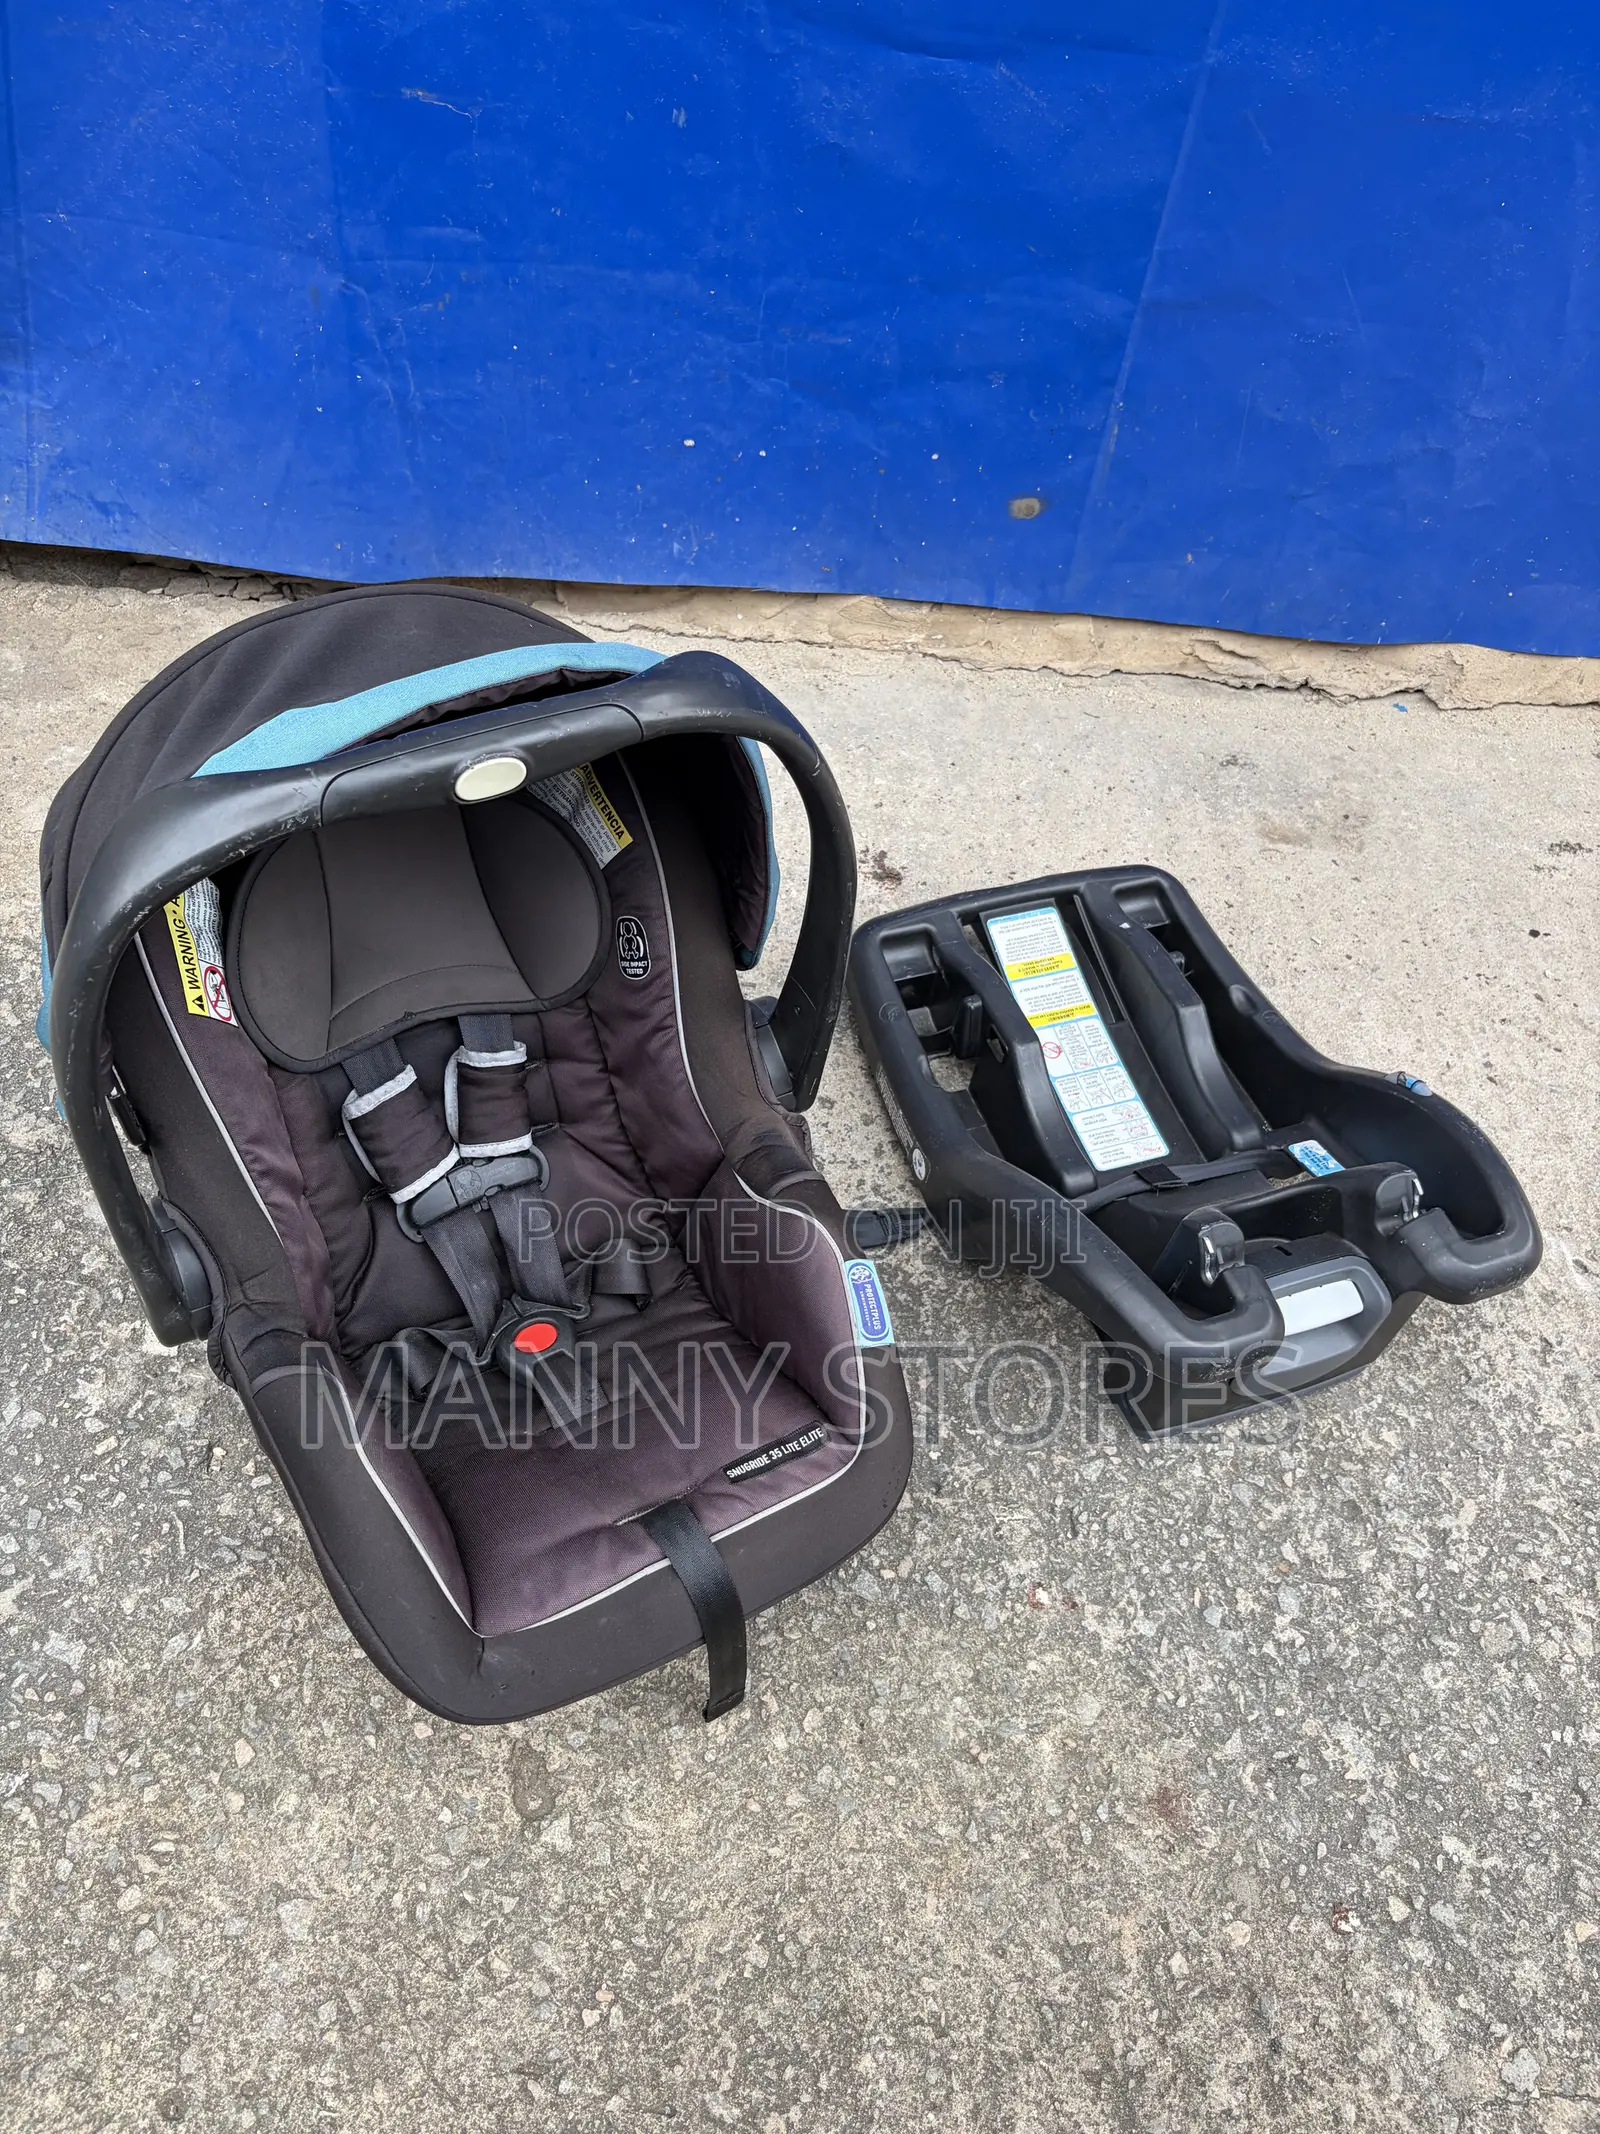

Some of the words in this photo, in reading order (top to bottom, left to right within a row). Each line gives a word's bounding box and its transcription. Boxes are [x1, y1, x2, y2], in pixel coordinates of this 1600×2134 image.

[580, 765, 625, 839] ADVERTENCIA
[172, 919, 199, 989] WARNING
[864, 1284, 881, 1330] PROTECTPLUS
[726, 1454, 771, 1478] SNUGRIDE
[769, 1448, 782, 1460] 35
[781, 1441, 801, 1454] LITE
[799, 1428, 824, 1447] ELITE
